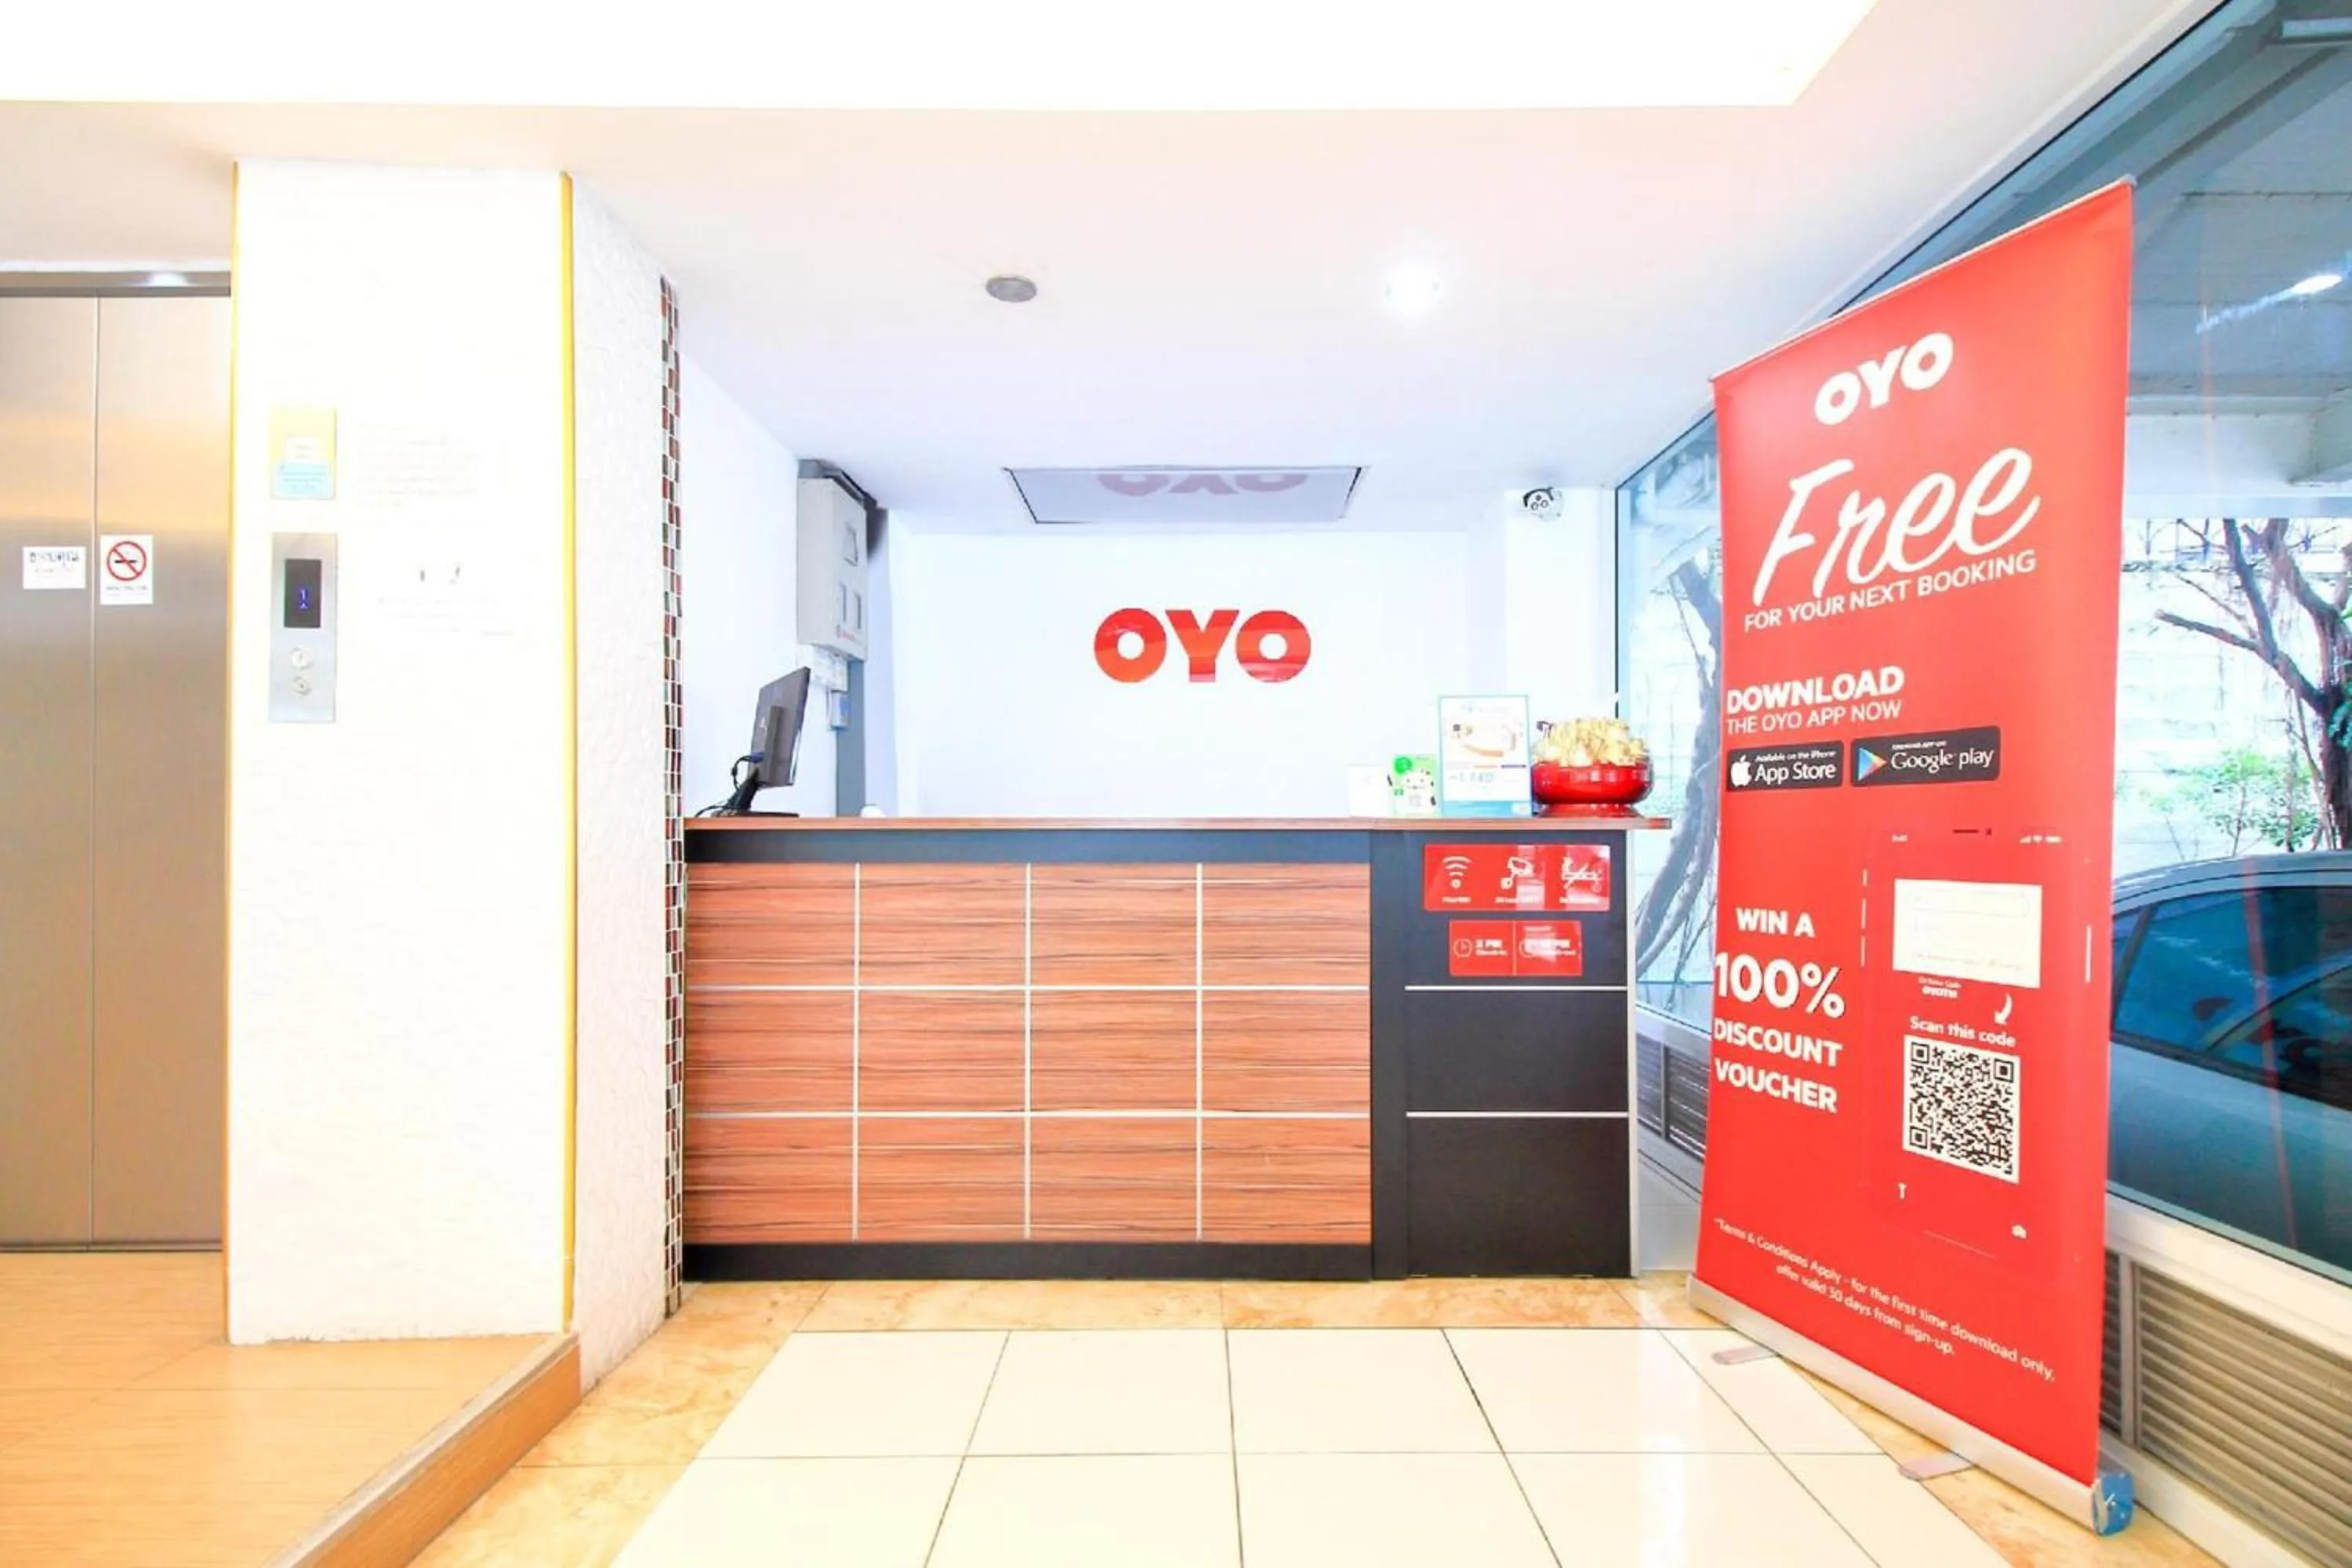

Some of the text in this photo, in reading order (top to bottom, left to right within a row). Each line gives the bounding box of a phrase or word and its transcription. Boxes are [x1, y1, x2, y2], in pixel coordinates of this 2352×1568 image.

[1813, 333, 1953, 425] OYO
[1754, 448, 2039, 605] Free
[1744, 550, 2036, 632] FOR YOUR NEXT BOOKING
[1094, 608, 1311, 683] OYO
[1726, 666, 1905, 714] DOWNLOAD
[1727, 700, 1902, 735] THE OYO APP NOW
[1755, 761, 1837, 785] App Store
[1891, 747, 1994, 774] Google play
[1736, 907, 1815, 938] WIN A
[1715, 952, 1845, 1018] 100%
[1715, 1018, 1842, 1067] DISCOUNT
[1910, 1015, 2017, 1048] Scan this code
[1715, 1058, 1837, 1113] VOUCHER
[1757, 1236, 1808, 1269] Conditions
[1810, 1260, 1842, 1284] Apply
[1851, 1277, 1868, 1294] for
[1870, 1287, 1890, 1305] the
[1892, 1294, 1916, 1316] first
[1919, 1308, 1948, 1330] time
[1950, 1323, 2018, 1363] download
[2020, 1356, 2056, 1381] only.
[1844, 1296, 1872, 1317] days
[1873, 1307, 1902, 1330] from
